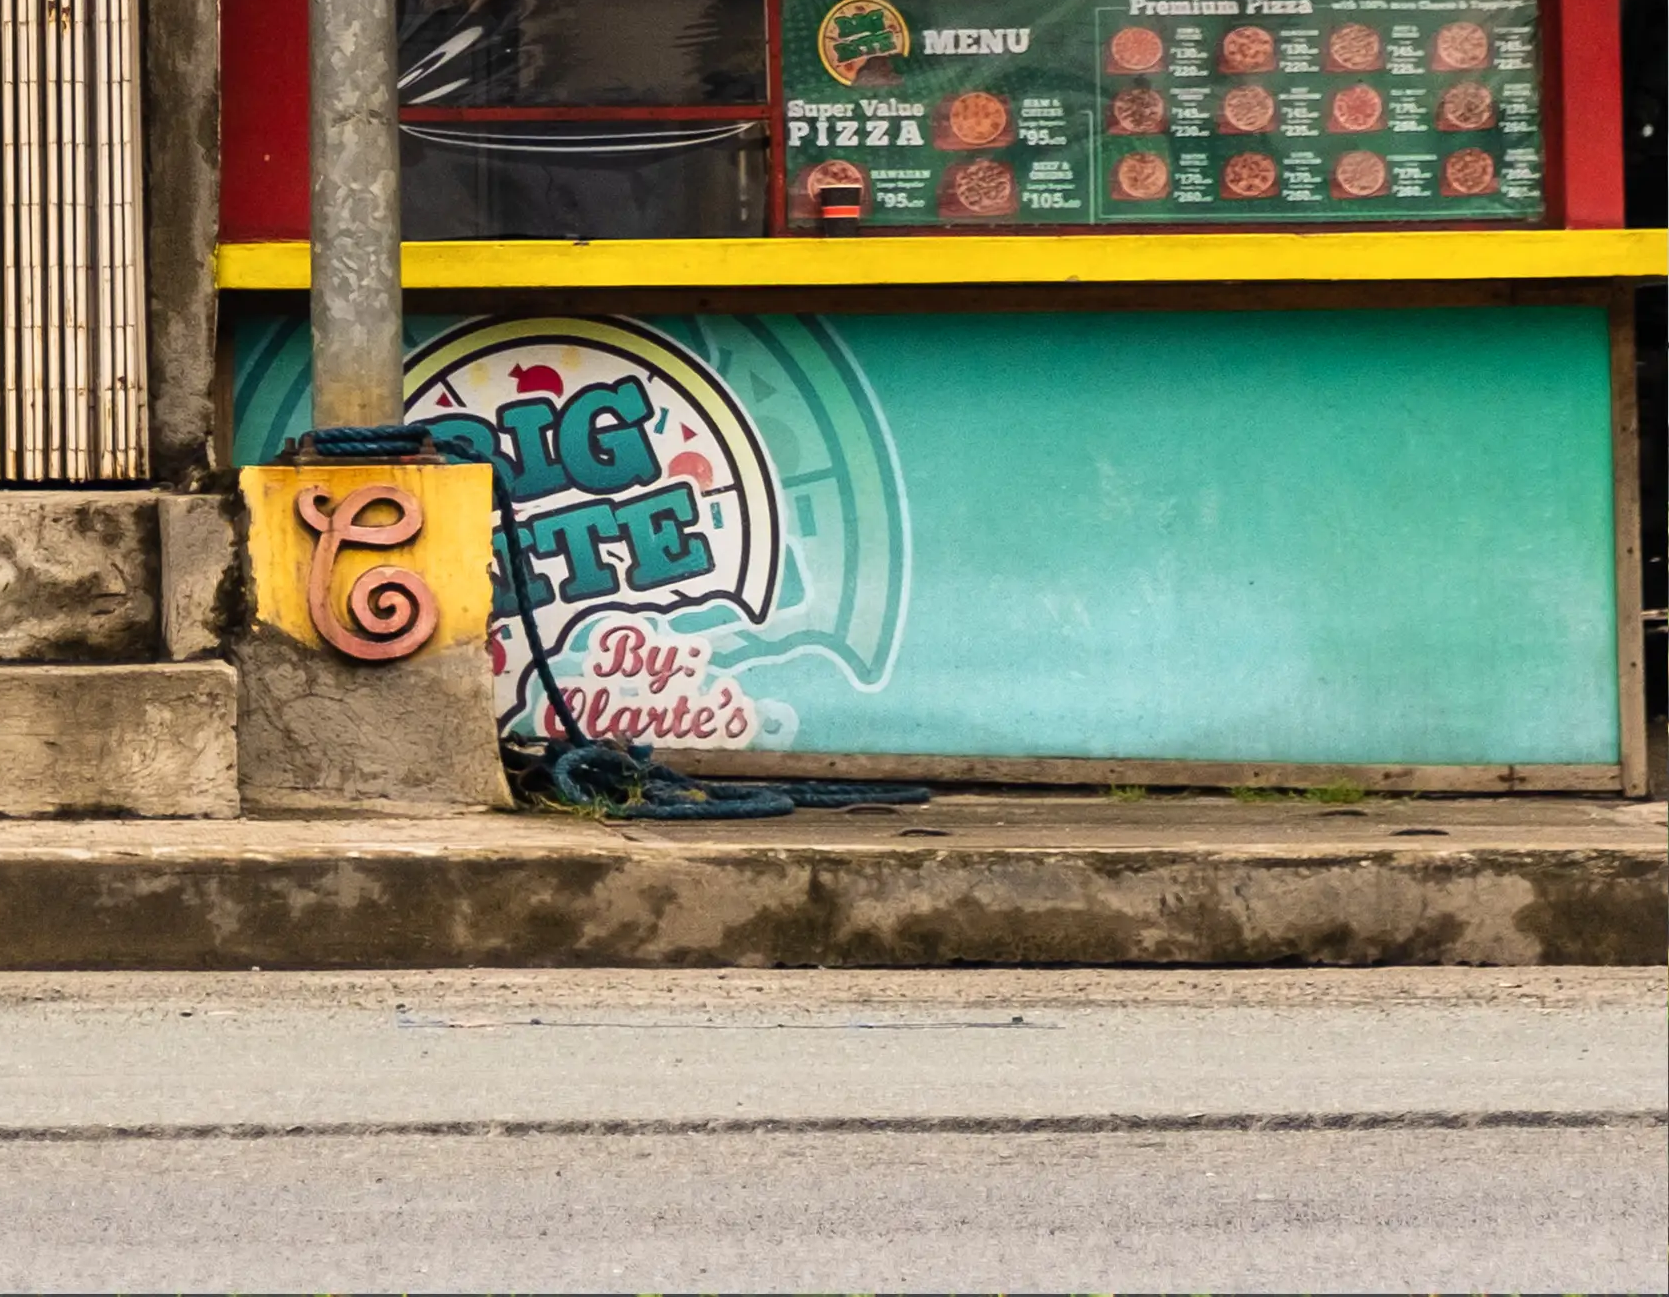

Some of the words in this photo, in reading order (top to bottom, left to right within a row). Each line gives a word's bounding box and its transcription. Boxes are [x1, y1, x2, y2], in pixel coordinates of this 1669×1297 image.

[922, 28, 1031, 55] MENU
[787, 99, 855, 121] Super
[860, 98, 925, 117] Value
[788, 120, 925, 146] PIZZA
[492, 480, 716, 618] ITE
[594, 624, 701, 693] By:
